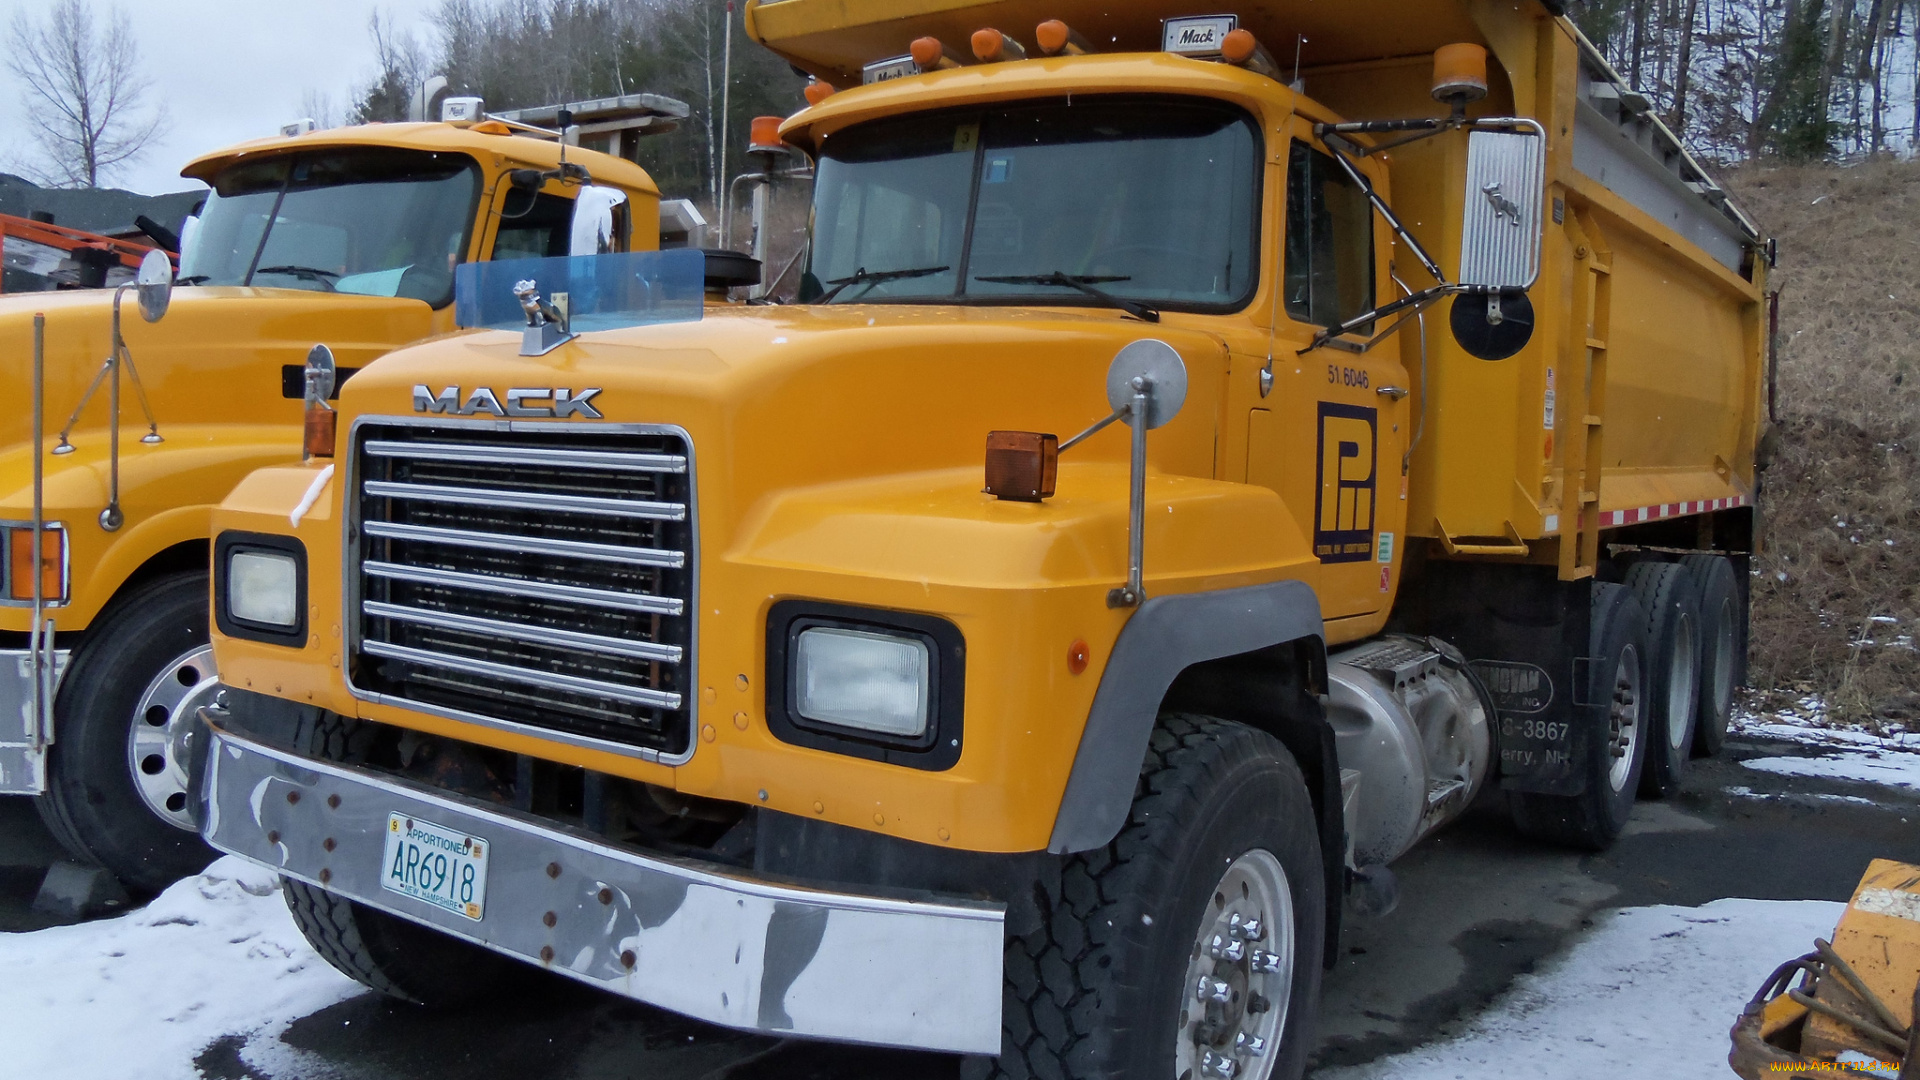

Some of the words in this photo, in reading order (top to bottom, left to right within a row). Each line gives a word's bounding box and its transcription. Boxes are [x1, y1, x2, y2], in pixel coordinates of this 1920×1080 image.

[1179, 28, 1214, 44] Mack
[413, 384, 604, 419] MACK
[406, 827, 470, 856] APPORTIONED
[391, 840, 475, 904] AR6918
[404, 884, 420, 895] NEW
[421, 889, 459, 909] HAMPSHIRE
